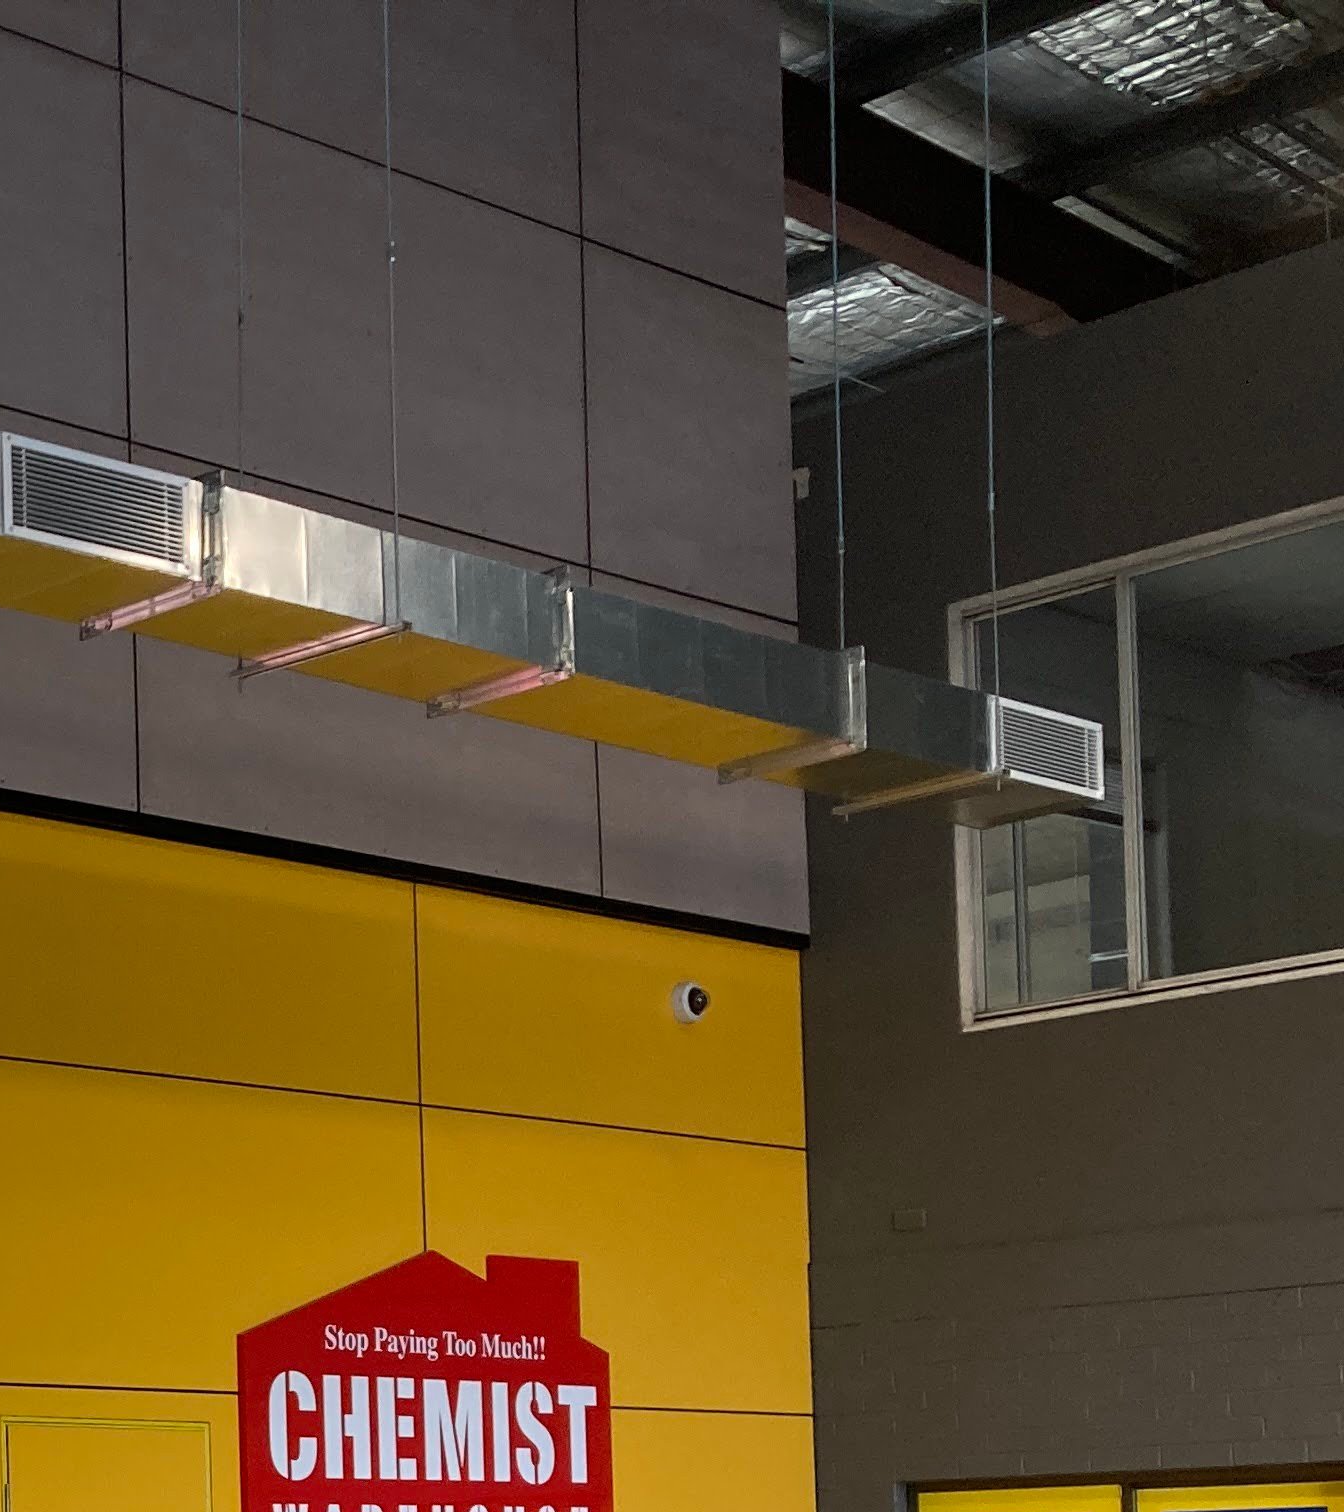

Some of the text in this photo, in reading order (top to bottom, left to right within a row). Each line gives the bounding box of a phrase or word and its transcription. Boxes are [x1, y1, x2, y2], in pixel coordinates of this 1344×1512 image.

[324, 1324, 546, 1361] Stop Paying Too Much!!
[268, 1370, 597, 1485] CHEMIST
